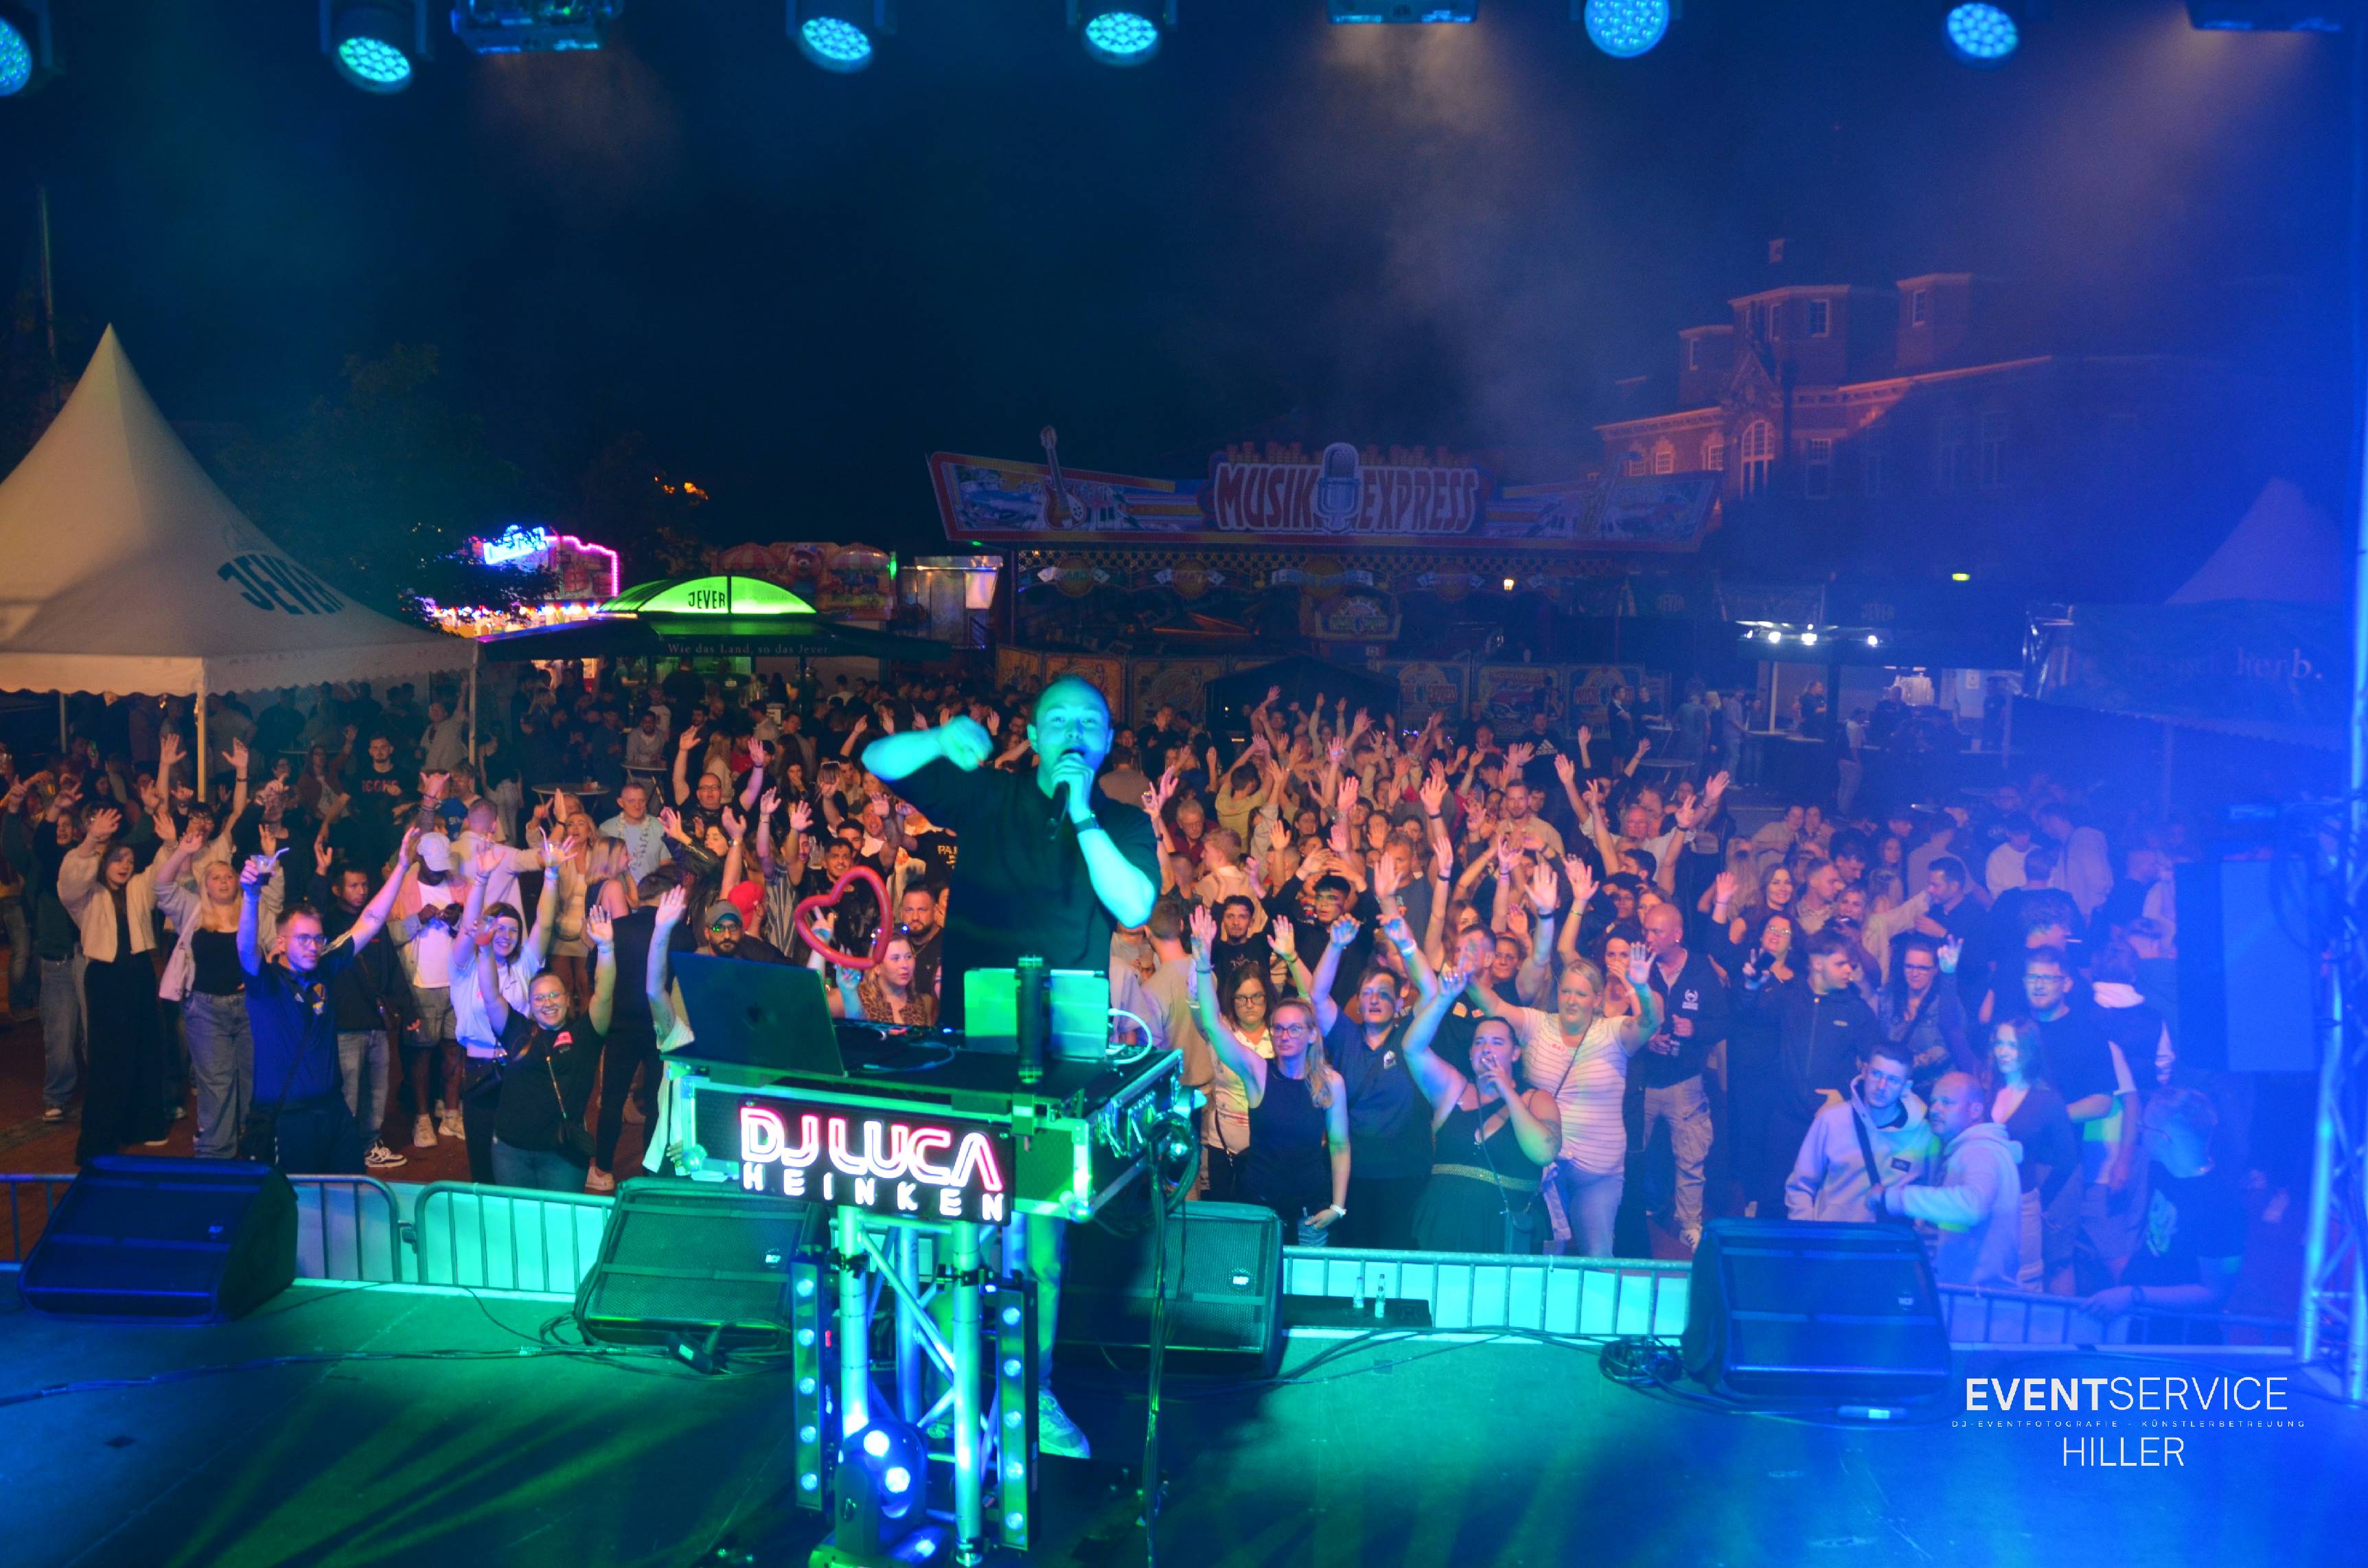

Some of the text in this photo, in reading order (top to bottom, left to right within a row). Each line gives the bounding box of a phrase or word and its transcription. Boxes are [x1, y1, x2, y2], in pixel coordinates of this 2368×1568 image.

[1215, 463, 1479, 533] MUSIK EXPRESS
[688, 590, 726, 610] JEVER
[667, 643, 691, 653] Wie
[696, 643, 715, 653] das
[721, 643, 753, 654] Land,
[775, 643, 794, 653] das
[741, 1107, 1003, 1192] DJ LUCA
[743, 1162, 1004, 1222] HEINKEN
